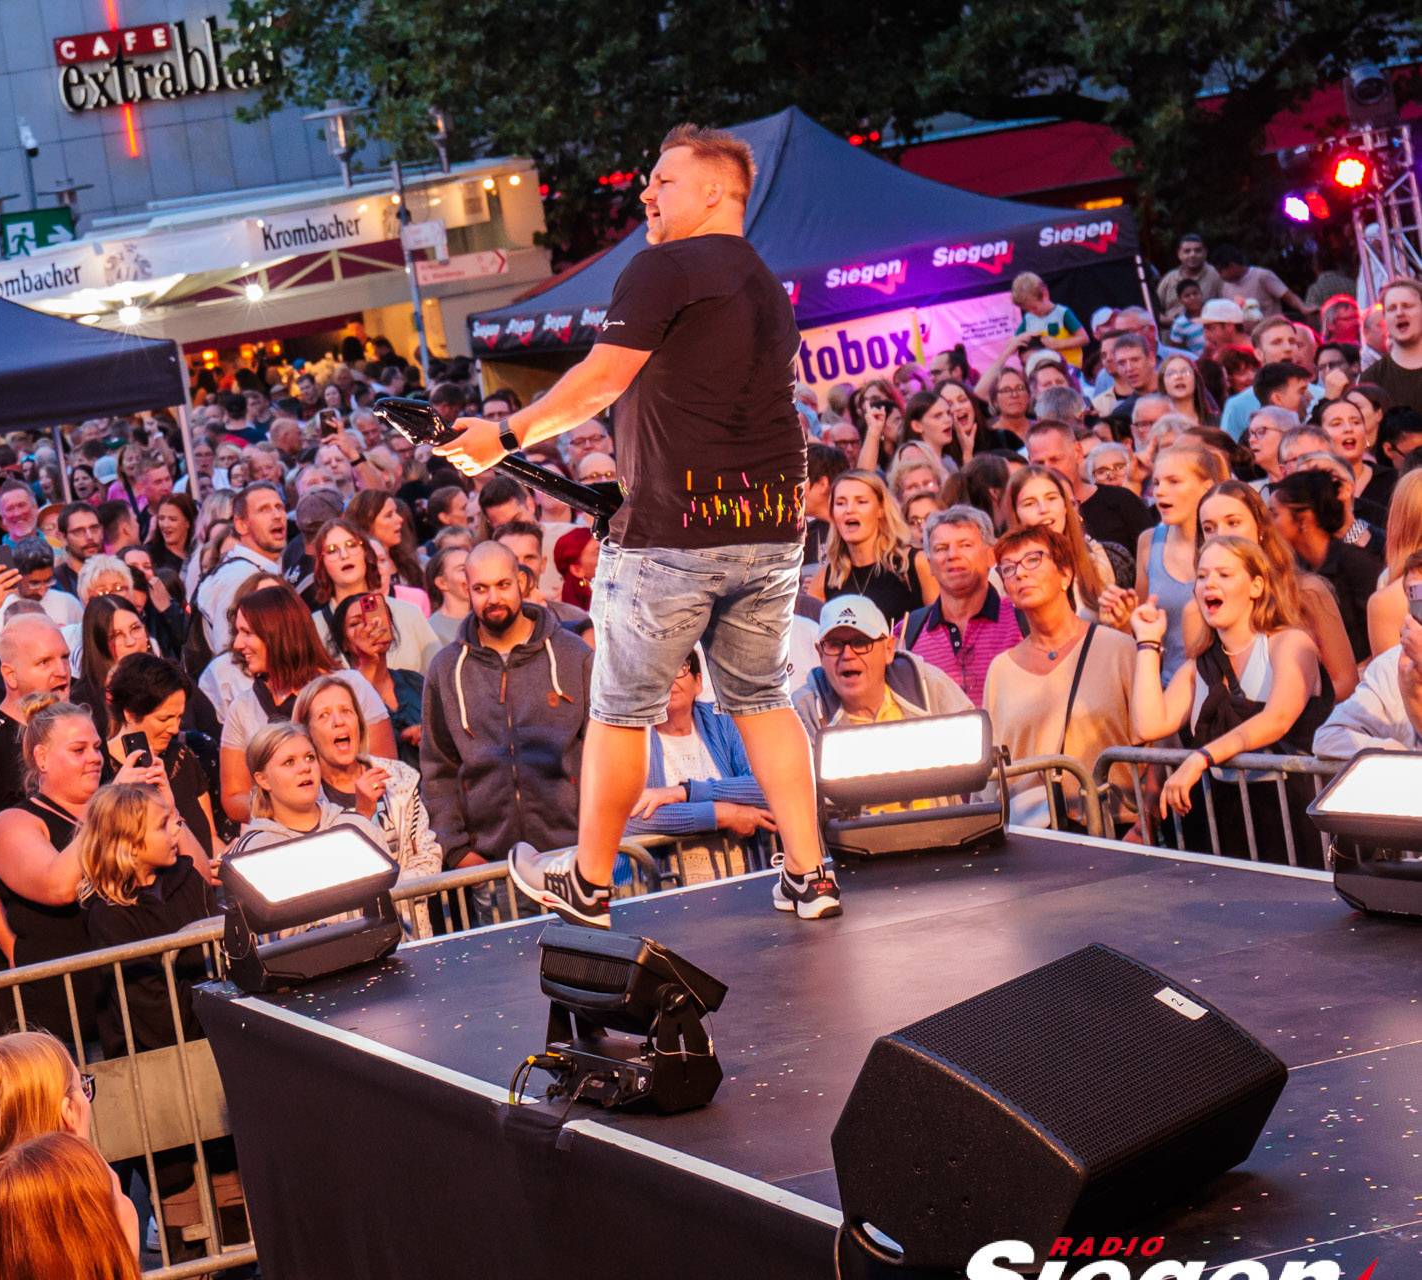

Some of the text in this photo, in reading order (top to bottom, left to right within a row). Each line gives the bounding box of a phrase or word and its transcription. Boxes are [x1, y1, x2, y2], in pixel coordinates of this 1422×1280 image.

[60, 28, 167, 59] CAFE
[59, 12, 284, 113] extrabla
[260, 205, 361, 251] Krombacher
[1039, 220, 1114, 248] Siegen
[932, 240, 1009, 268] Siegen
[825, 259, 902, 289] Siegen
[796, 330, 916, 384] tobox
